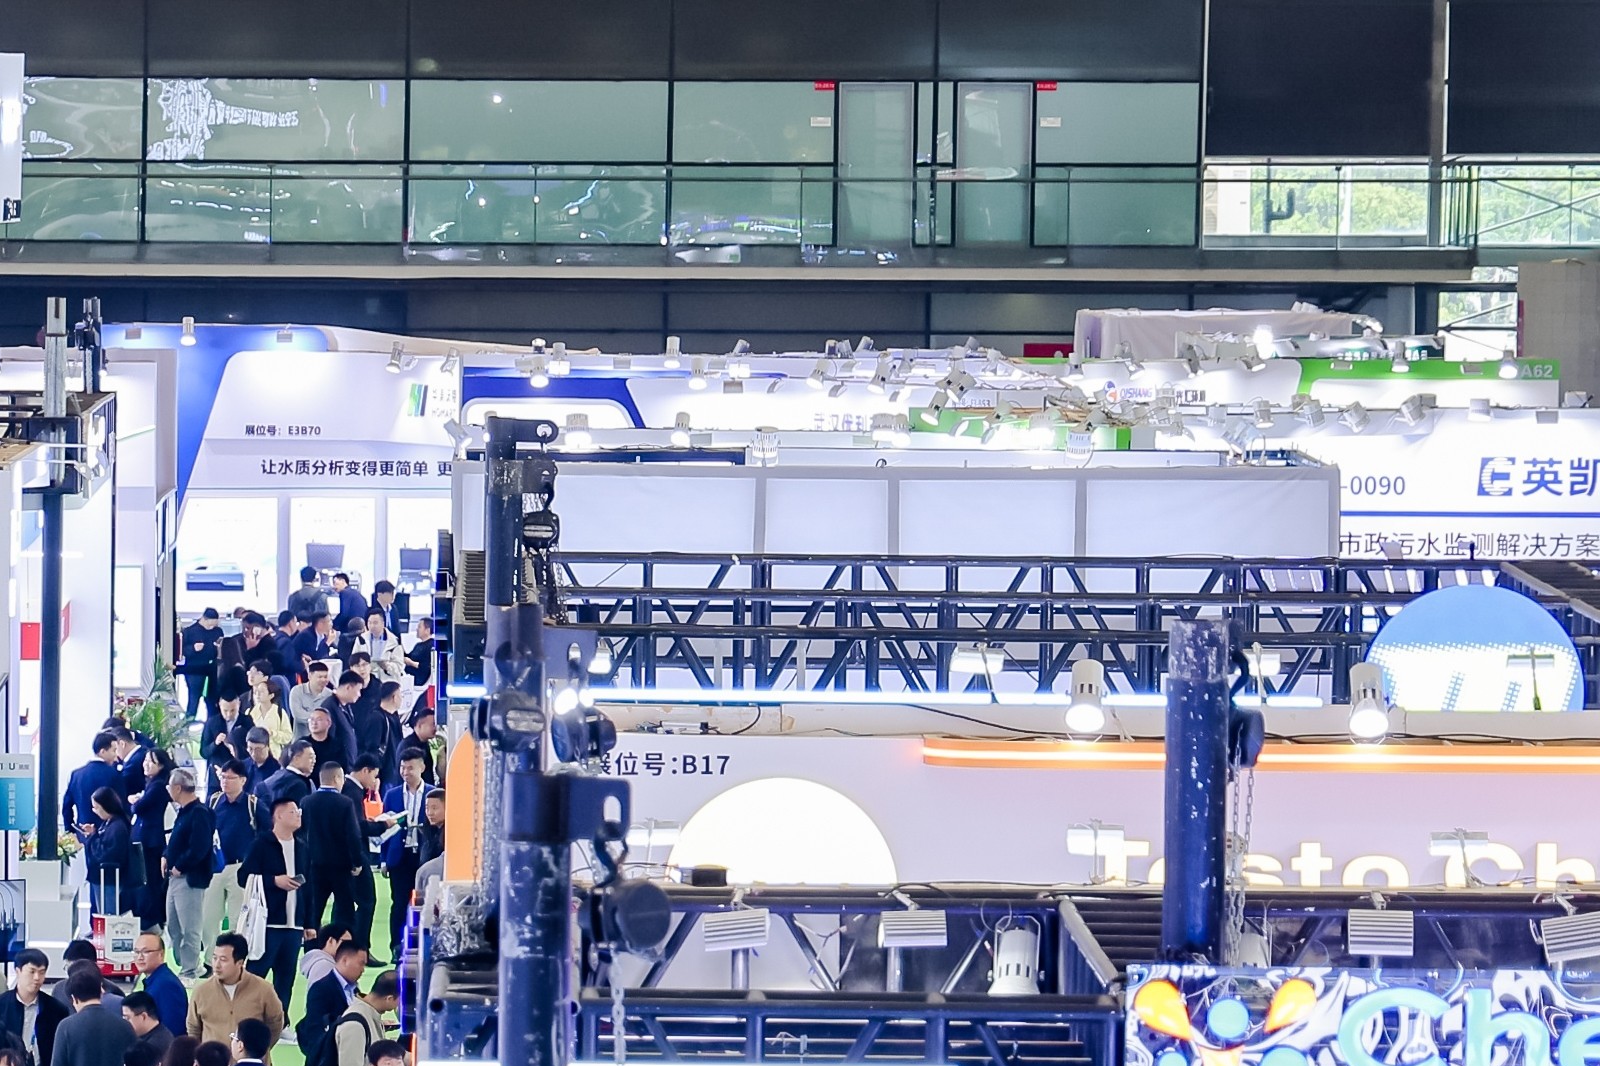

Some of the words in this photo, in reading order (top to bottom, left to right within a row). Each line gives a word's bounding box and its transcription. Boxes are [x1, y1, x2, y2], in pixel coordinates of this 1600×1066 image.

[260, 459, 429, 477] 让水质分析变得更简单
[1340, 531, 1600, 557] 市政污水监测解决方案
